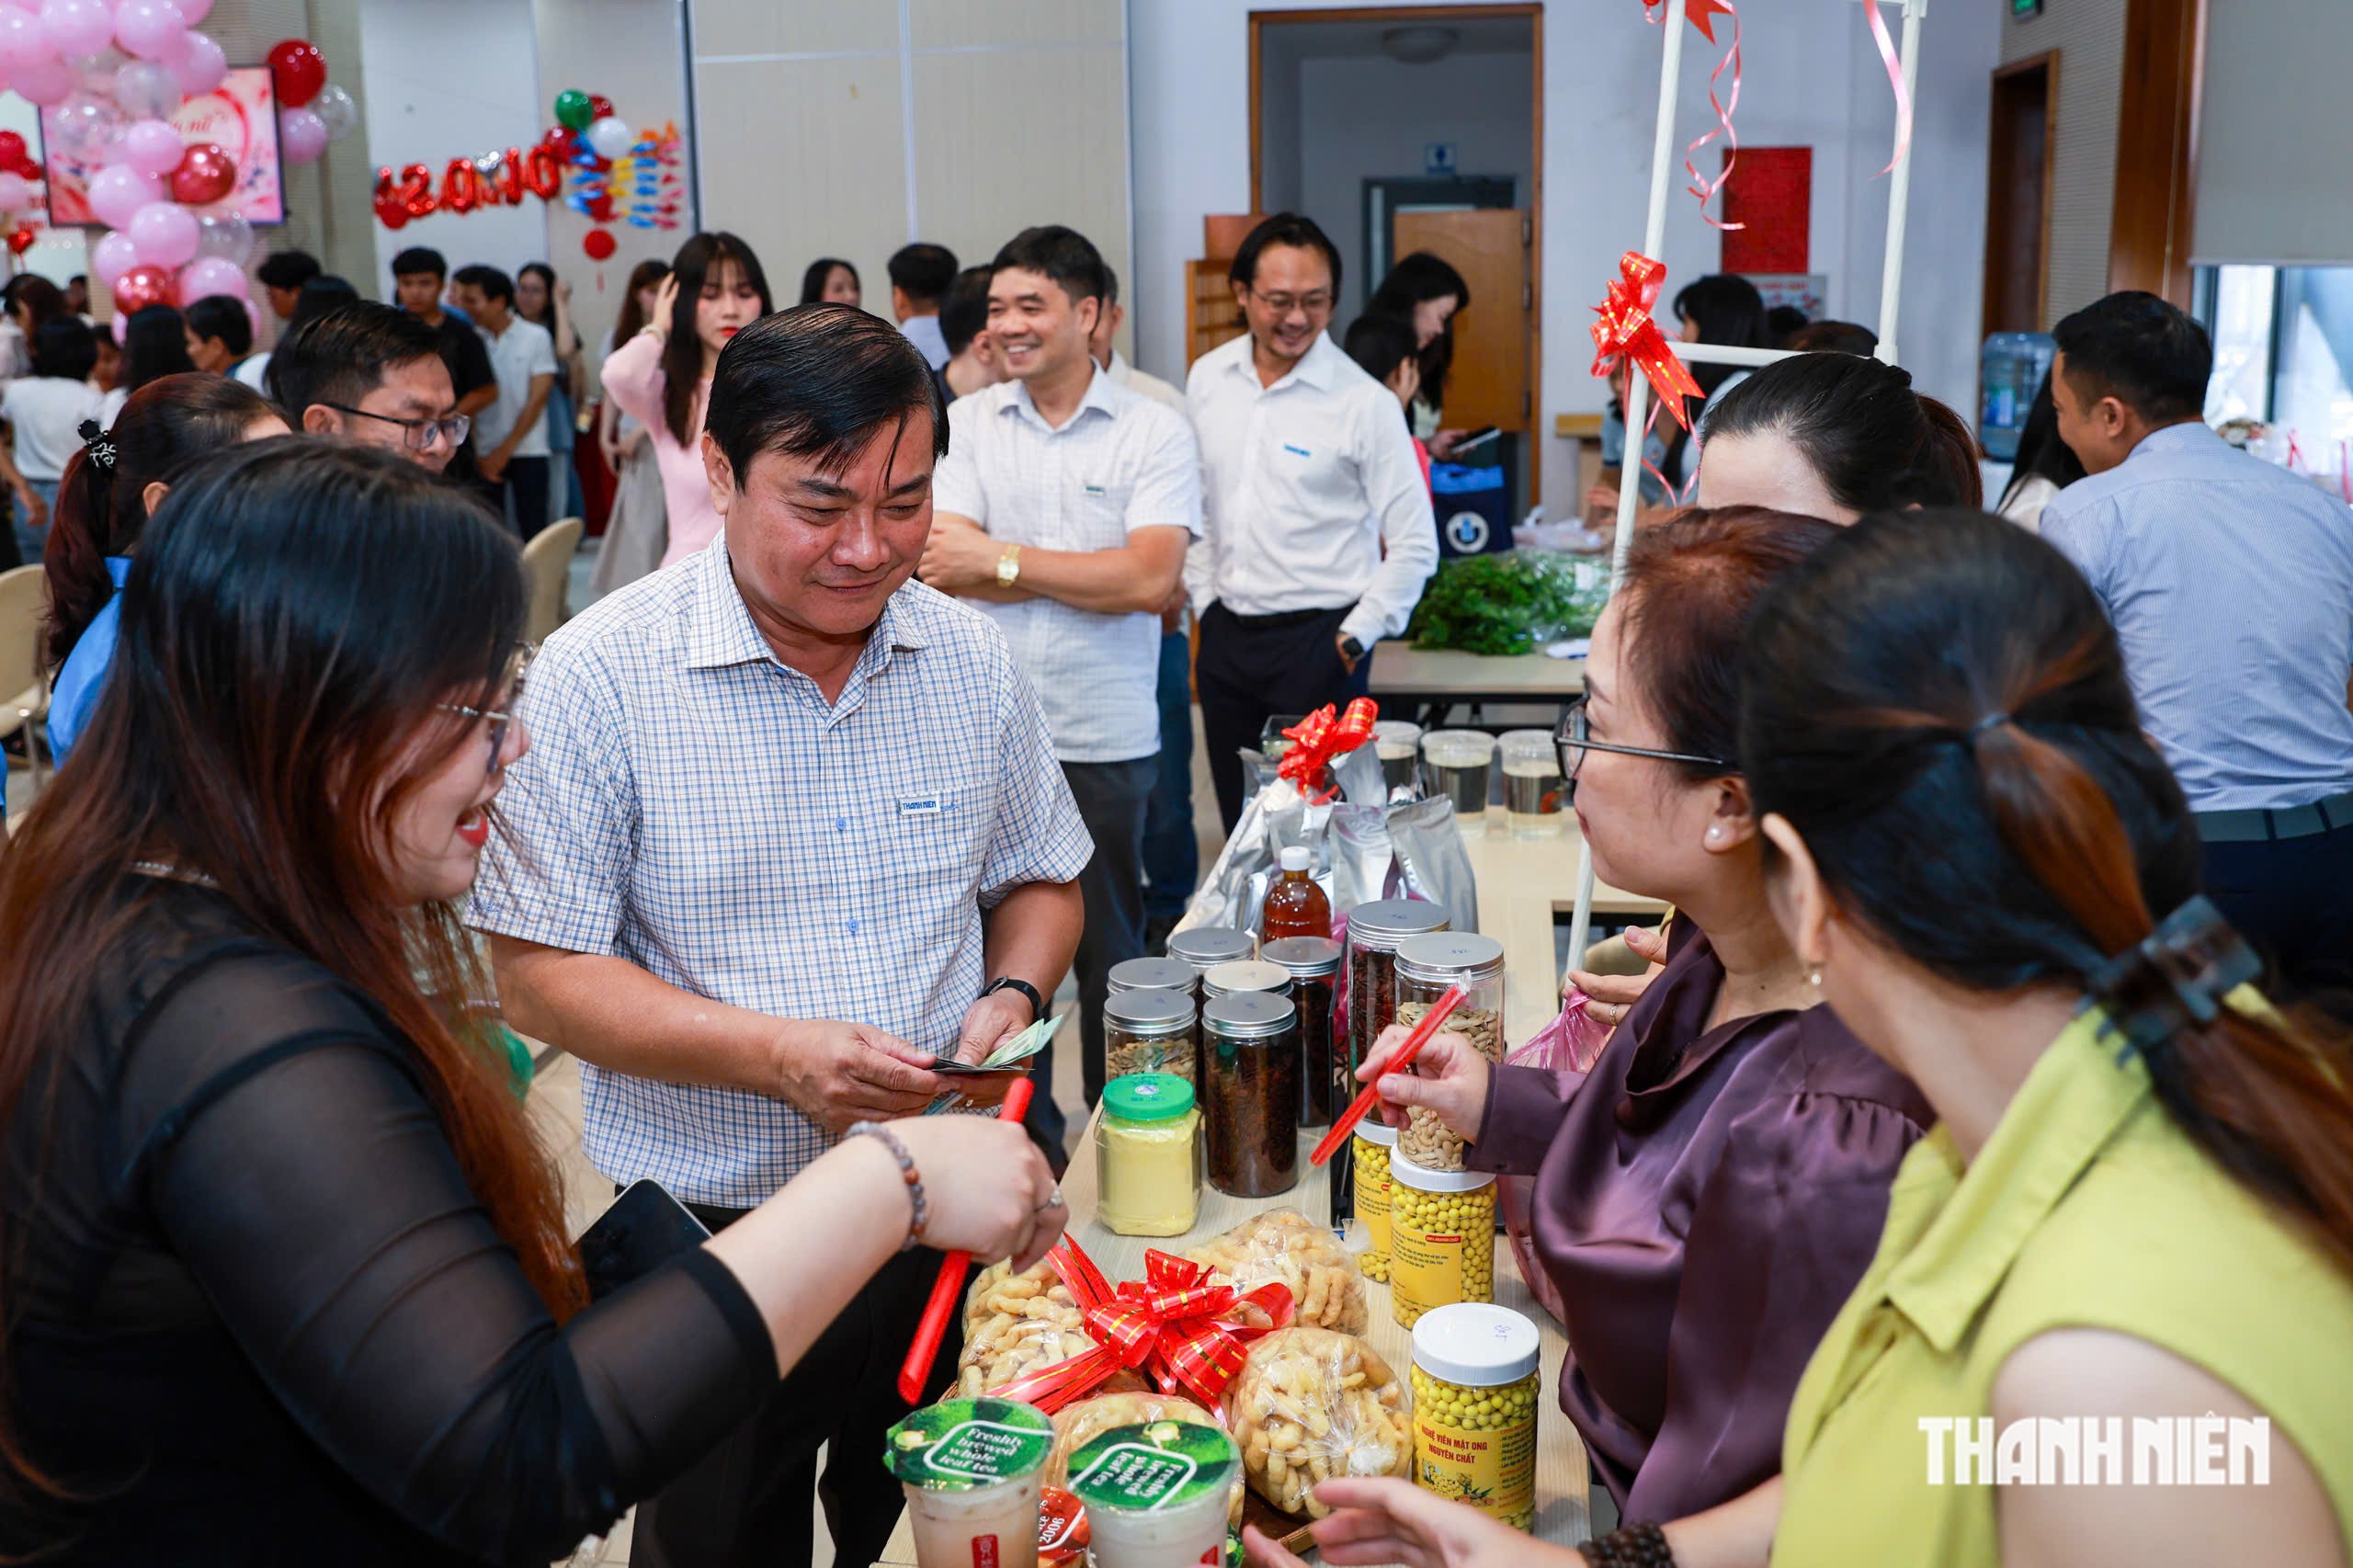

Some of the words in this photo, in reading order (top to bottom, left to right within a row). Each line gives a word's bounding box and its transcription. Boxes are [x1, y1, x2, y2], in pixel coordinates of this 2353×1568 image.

[956, 1437, 1018, 1457] brewed
[966, 1427, 1026, 1448] Freshly
[1453, 1439, 1470, 1450] MẬT
[1472, 1441, 1488, 1450] ONG
[938, 1454, 972, 1469] leaf
[972, 1460, 999, 1473] tea
[949, 1446, 996, 1464] whole
[1108, 1450, 1134, 1473] leaf
[1115, 1455, 1148, 1485] whole
[1124, 1460, 1167, 1496] brewed
[1140, 1462, 1184, 1498] Freshly
[1039, 1517, 1065, 1545] 2006
